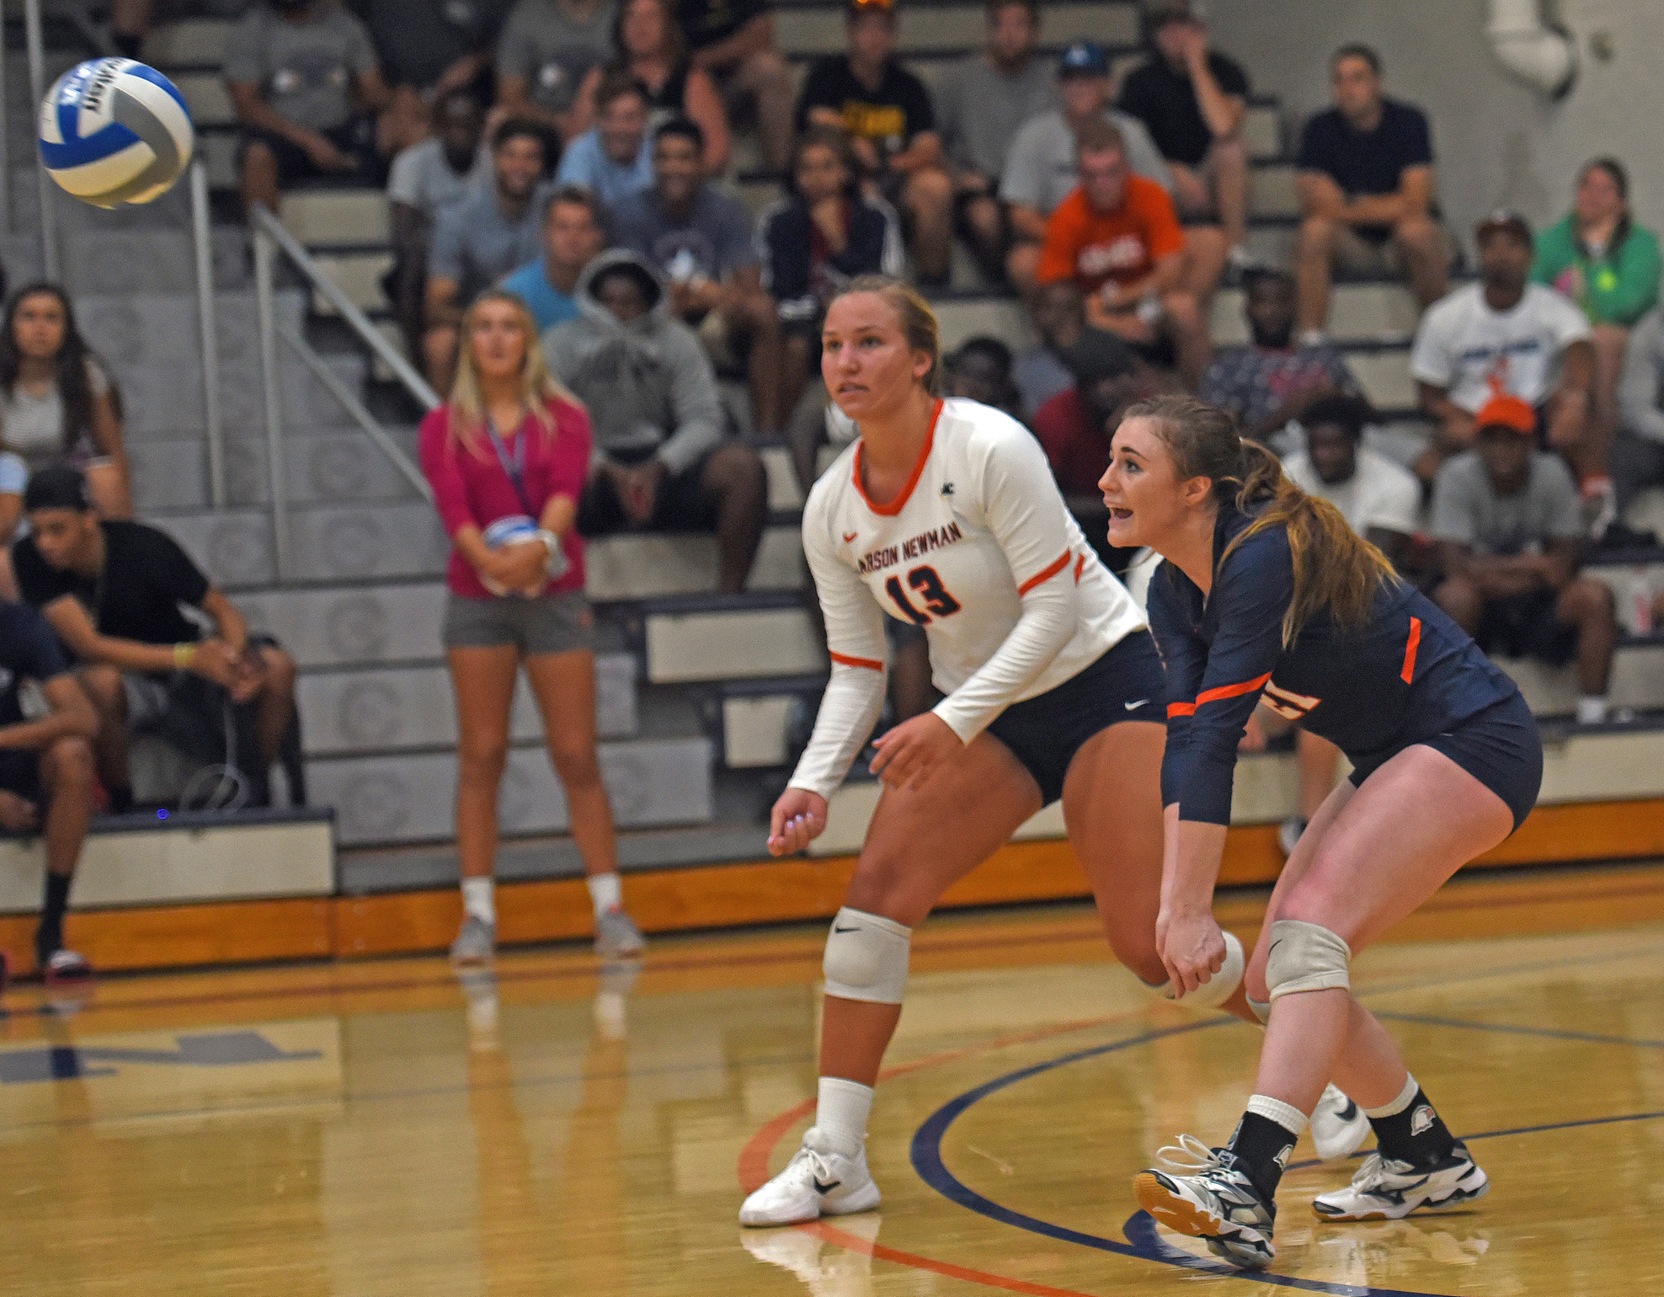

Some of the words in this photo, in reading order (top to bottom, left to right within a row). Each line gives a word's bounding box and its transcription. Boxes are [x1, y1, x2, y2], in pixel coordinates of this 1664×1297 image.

[857, 546, 898, 575] ARSON
[902, 521, 962, 562] NEWMAN
[885, 564, 962, 625] 13
